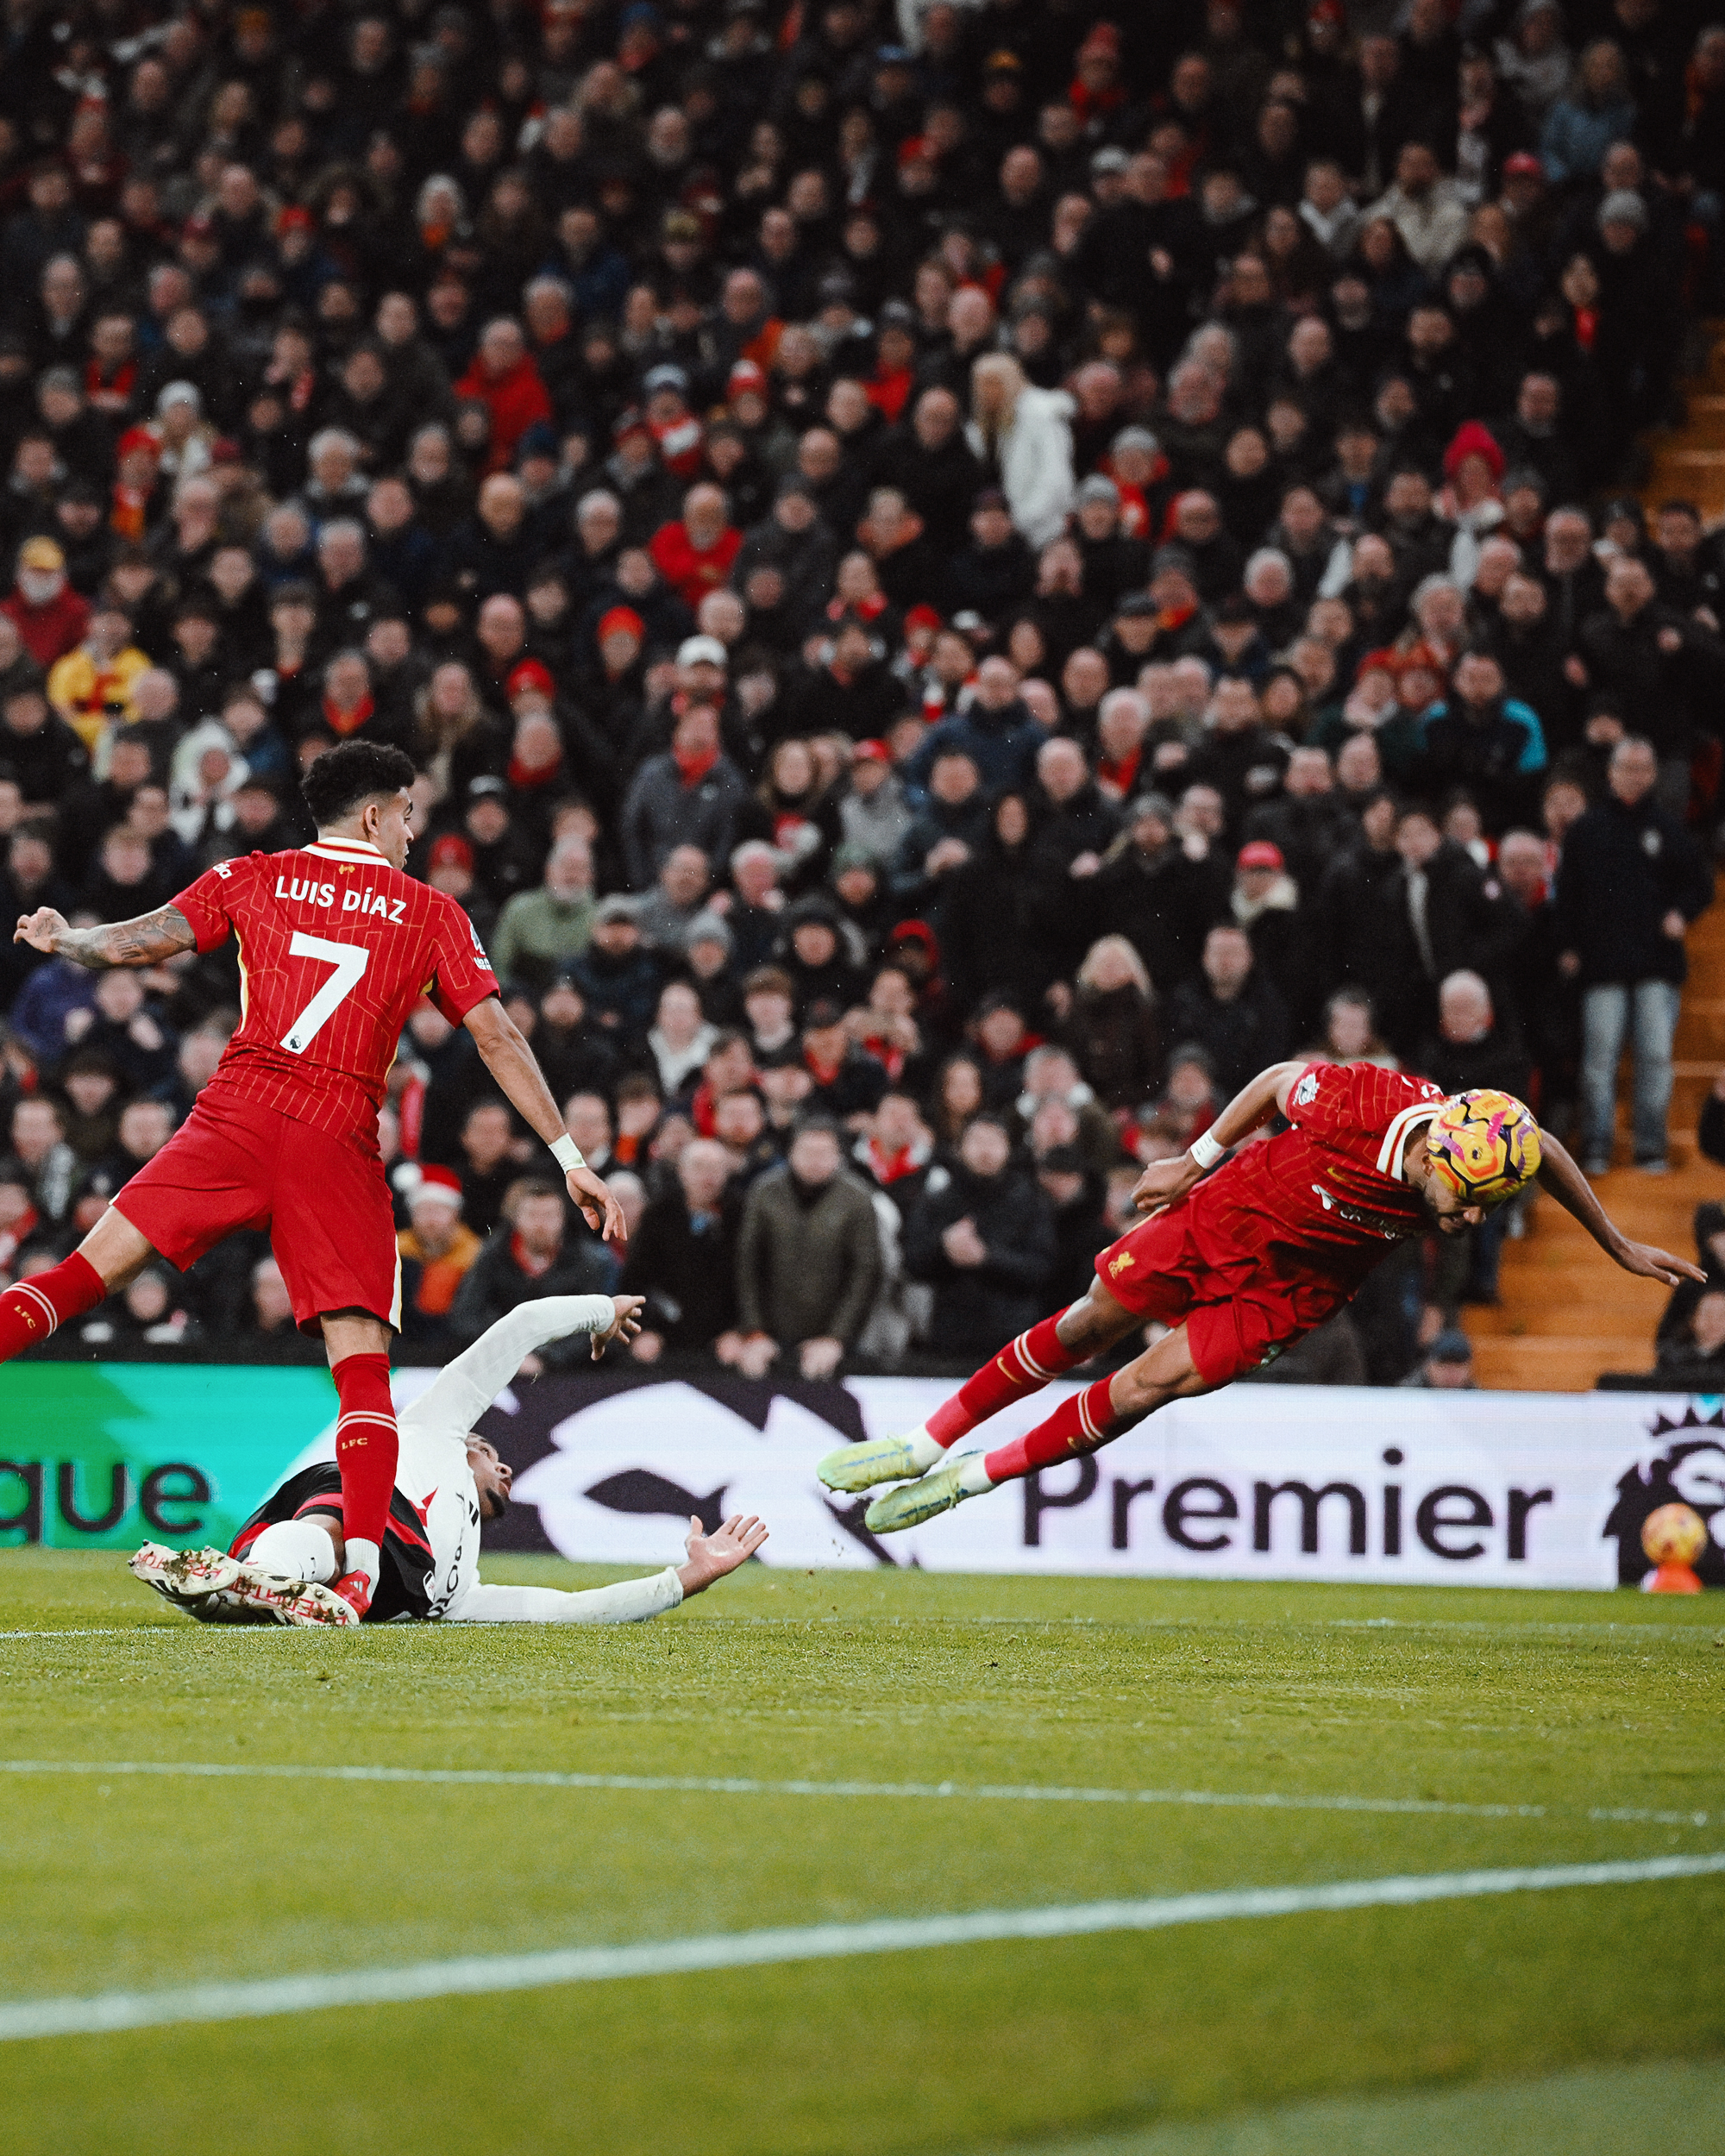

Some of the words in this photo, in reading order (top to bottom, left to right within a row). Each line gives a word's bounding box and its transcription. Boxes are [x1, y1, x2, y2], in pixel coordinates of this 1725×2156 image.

[275, 875, 336, 907] LUIS
[342, 887, 407, 924] DÍAZ
[279, 931, 370, 1055] 7
[13, 1305, 36, 1329] LFC
[341, 1437, 368, 1450] LFC
[1023, 1448, 1553, 1560] Premier
